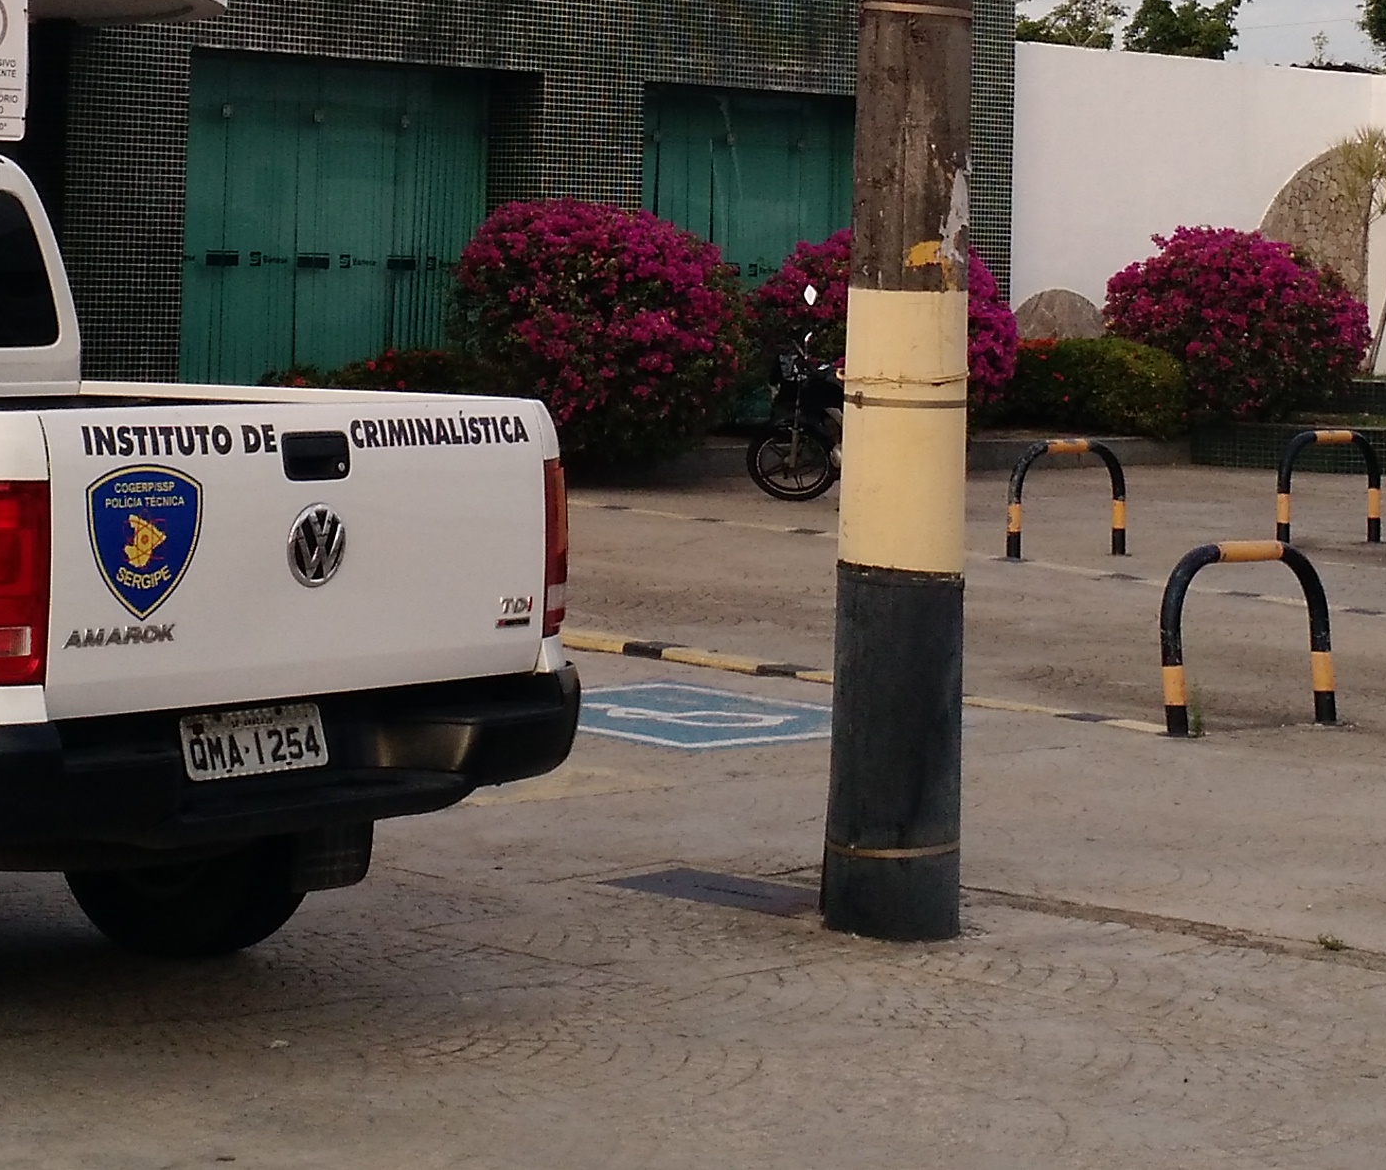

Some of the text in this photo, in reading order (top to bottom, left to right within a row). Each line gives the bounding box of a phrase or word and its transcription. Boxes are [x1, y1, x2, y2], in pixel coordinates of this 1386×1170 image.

[81, 410, 530, 456] INSTITUTO DE CRIMINALÍSTICA
[114, 481, 175, 494] COGERP/SSP
[105, 495, 185, 509] POLÍCIA TÉCNICA
[116, 565, 172, 590] SERGIPE
[499, 596, 533, 614] TDI
[62, 624, 175, 649] AMAROK
